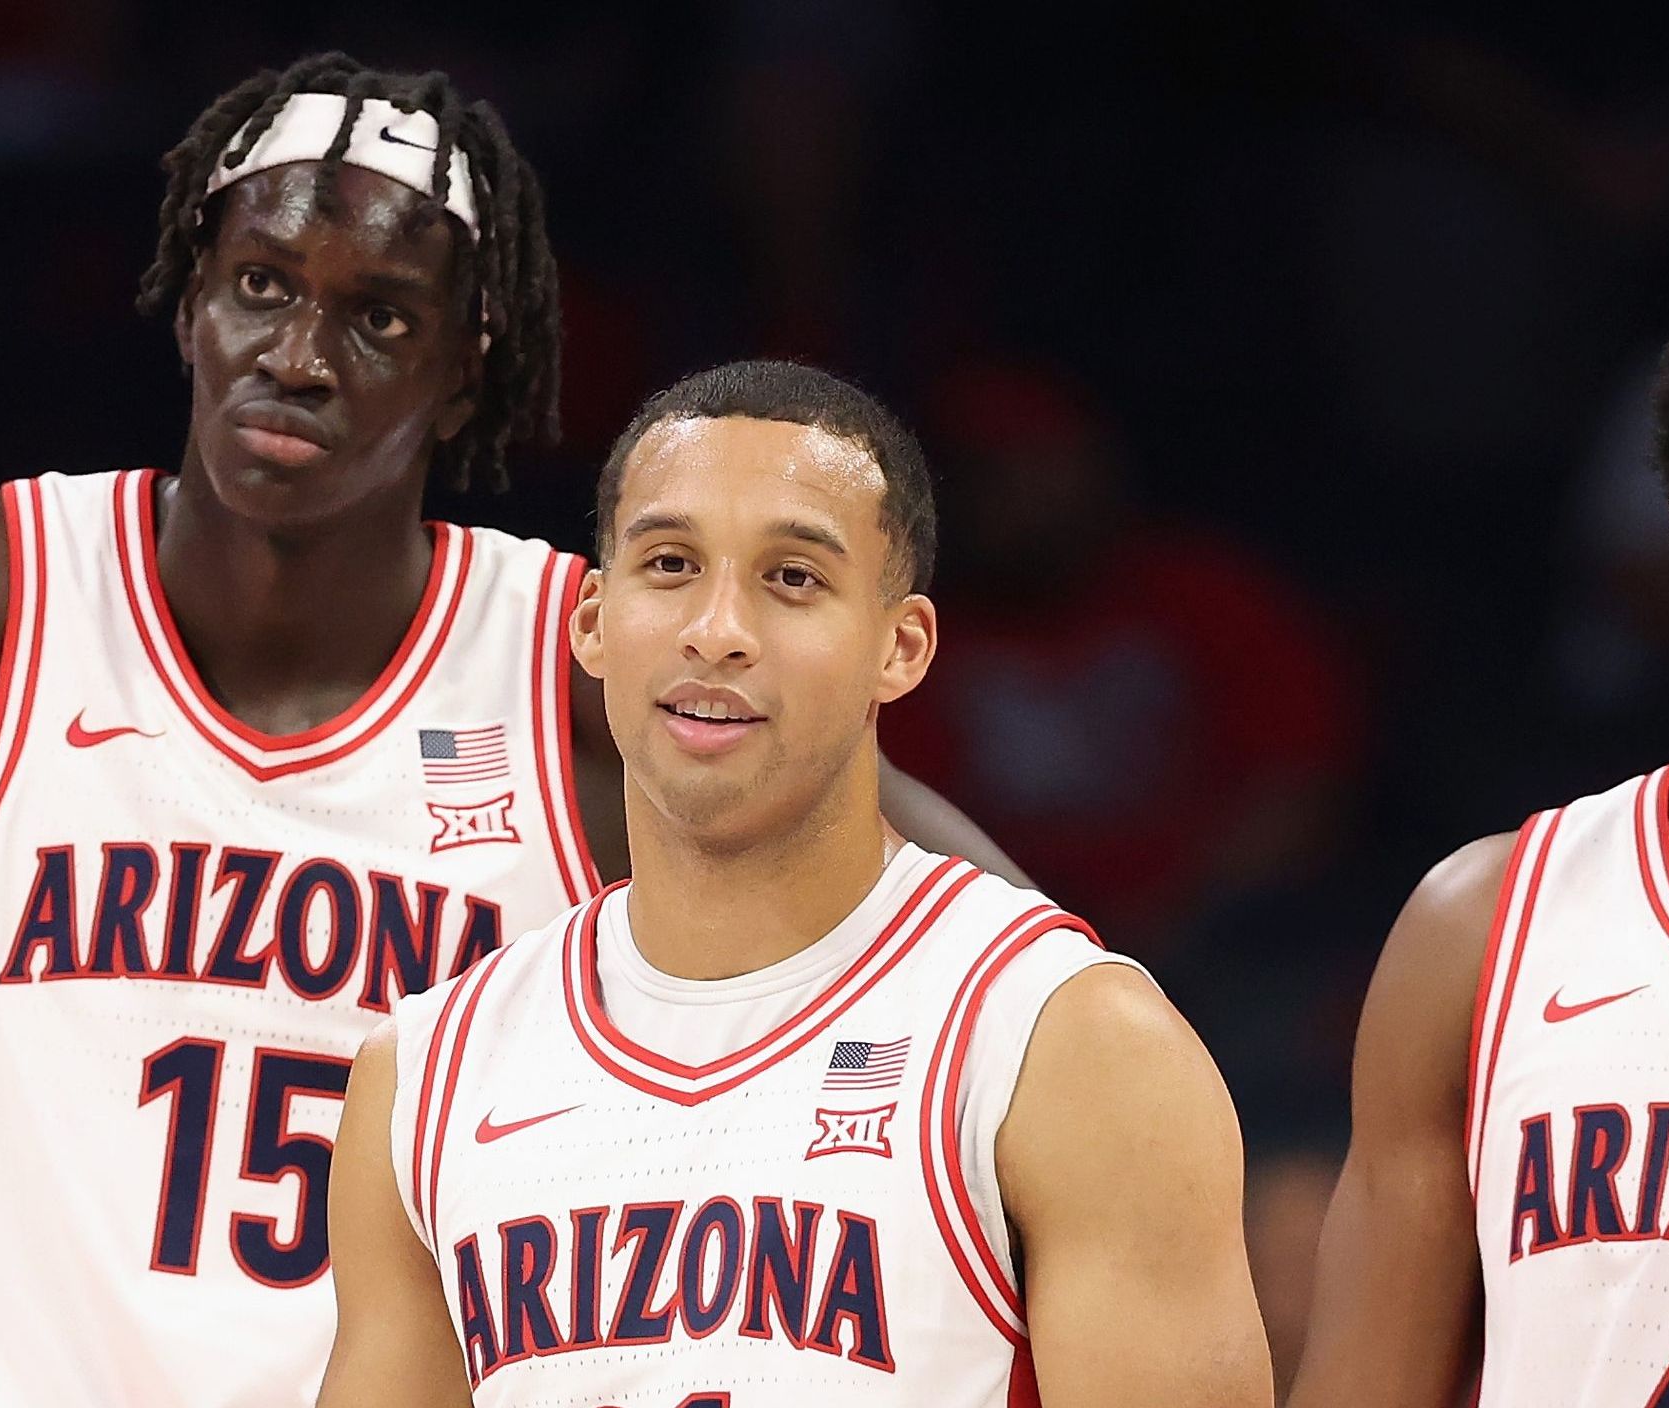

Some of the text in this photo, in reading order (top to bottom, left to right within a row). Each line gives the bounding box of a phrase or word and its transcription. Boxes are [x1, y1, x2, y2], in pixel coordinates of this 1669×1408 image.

[427, 791, 522, 853] XII
[138, 1036, 355, 1289] 15
[805, 1101, 897, 1161] XII
[453, 1195, 896, 1393] ARIZONA
